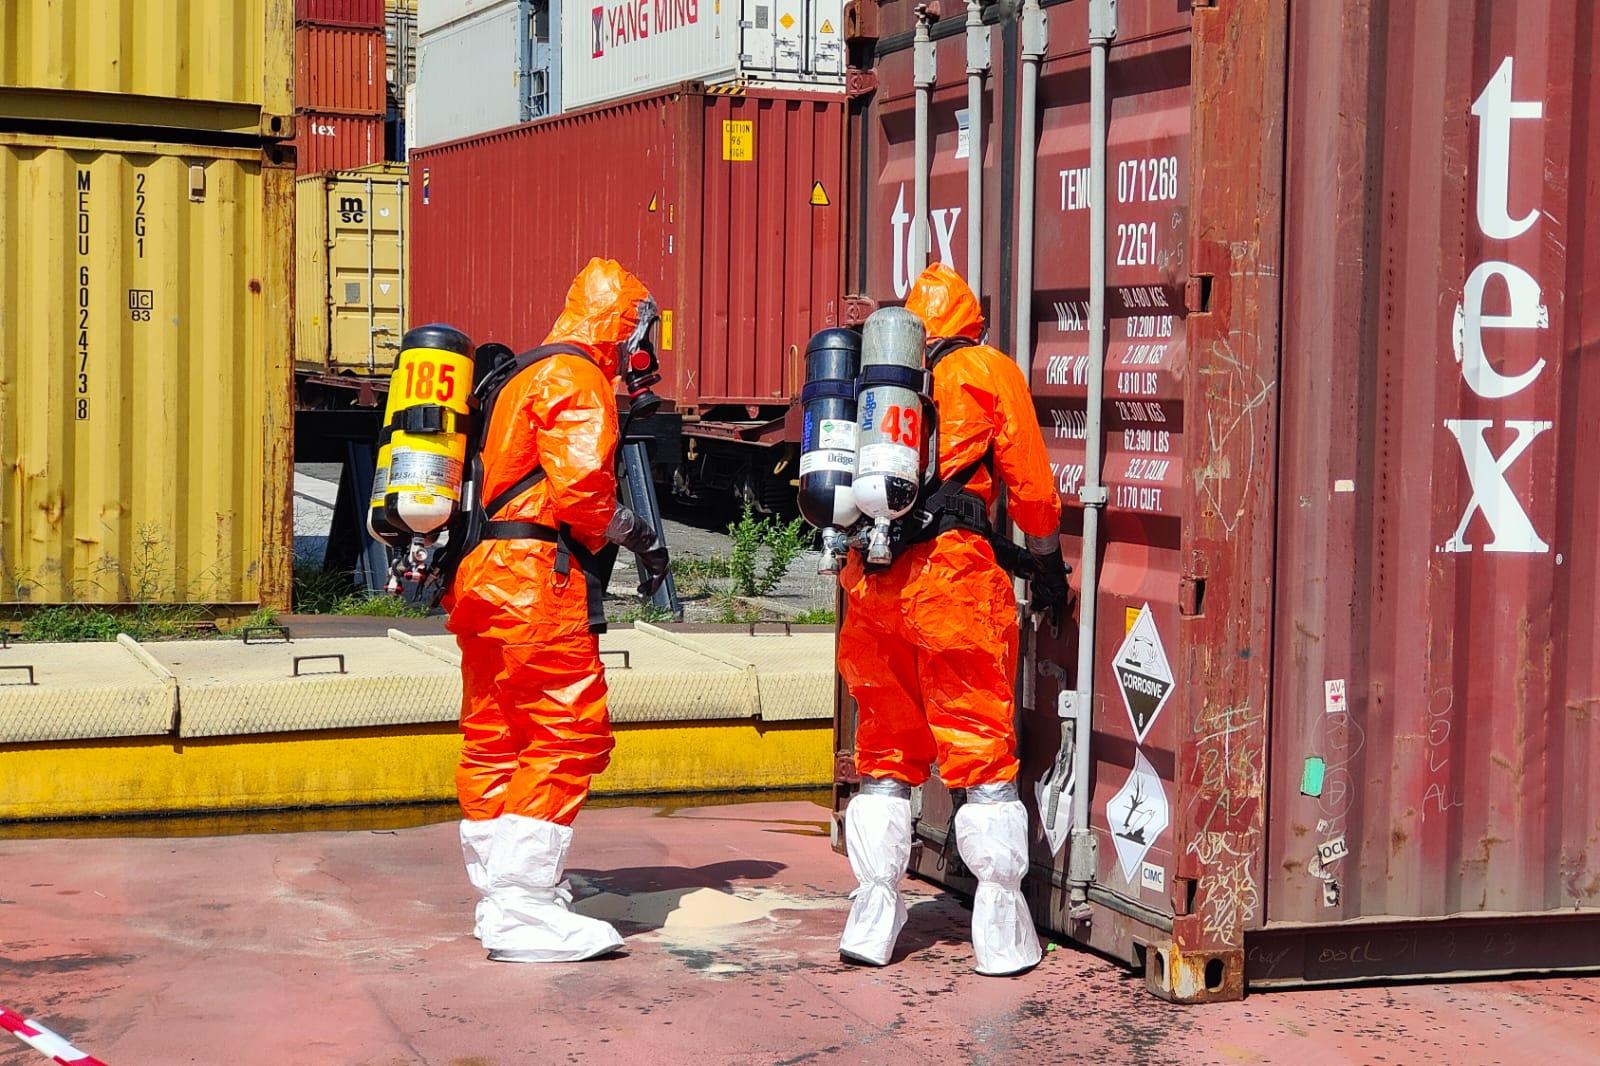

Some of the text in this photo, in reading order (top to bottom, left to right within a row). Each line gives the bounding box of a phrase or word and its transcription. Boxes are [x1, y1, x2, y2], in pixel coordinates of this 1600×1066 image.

[608, 0, 698, 48] YANG MING
[311, 122, 335, 136] tex
[1118, 156, 1177, 203] 071268
[78, 170, 90, 255] MEDU
[135, 173, 145, 258] 22G1
[1117, 222, 1156, 266] 22G1
[132, 311, 150, 321] 83
[1053, 302, 1083, 331] MAX.
[1437, 56, 1553, 552] tex
[1127, 315, 1172, 337] 67.200 LBS
[405, 361, 455, 402] 185
[1046, 356, 1073, 384] TARE
[1118, 372, 1157, 394] 4.810 LBS
[1144, 402, 1166, 422] KGS
[880, 405, 918, 449] 43
[1124, 429, 1169, 452] 62.390 LBS
[1125, 458, 1147, 478] 33.2
[1117, 486, 1138, 509] 1.170
[1123, 673, 1162, 699] CORROSIVE
[1138, 712, 1144, 728] 8
[1143, 868, 1163, 884] CIMC
